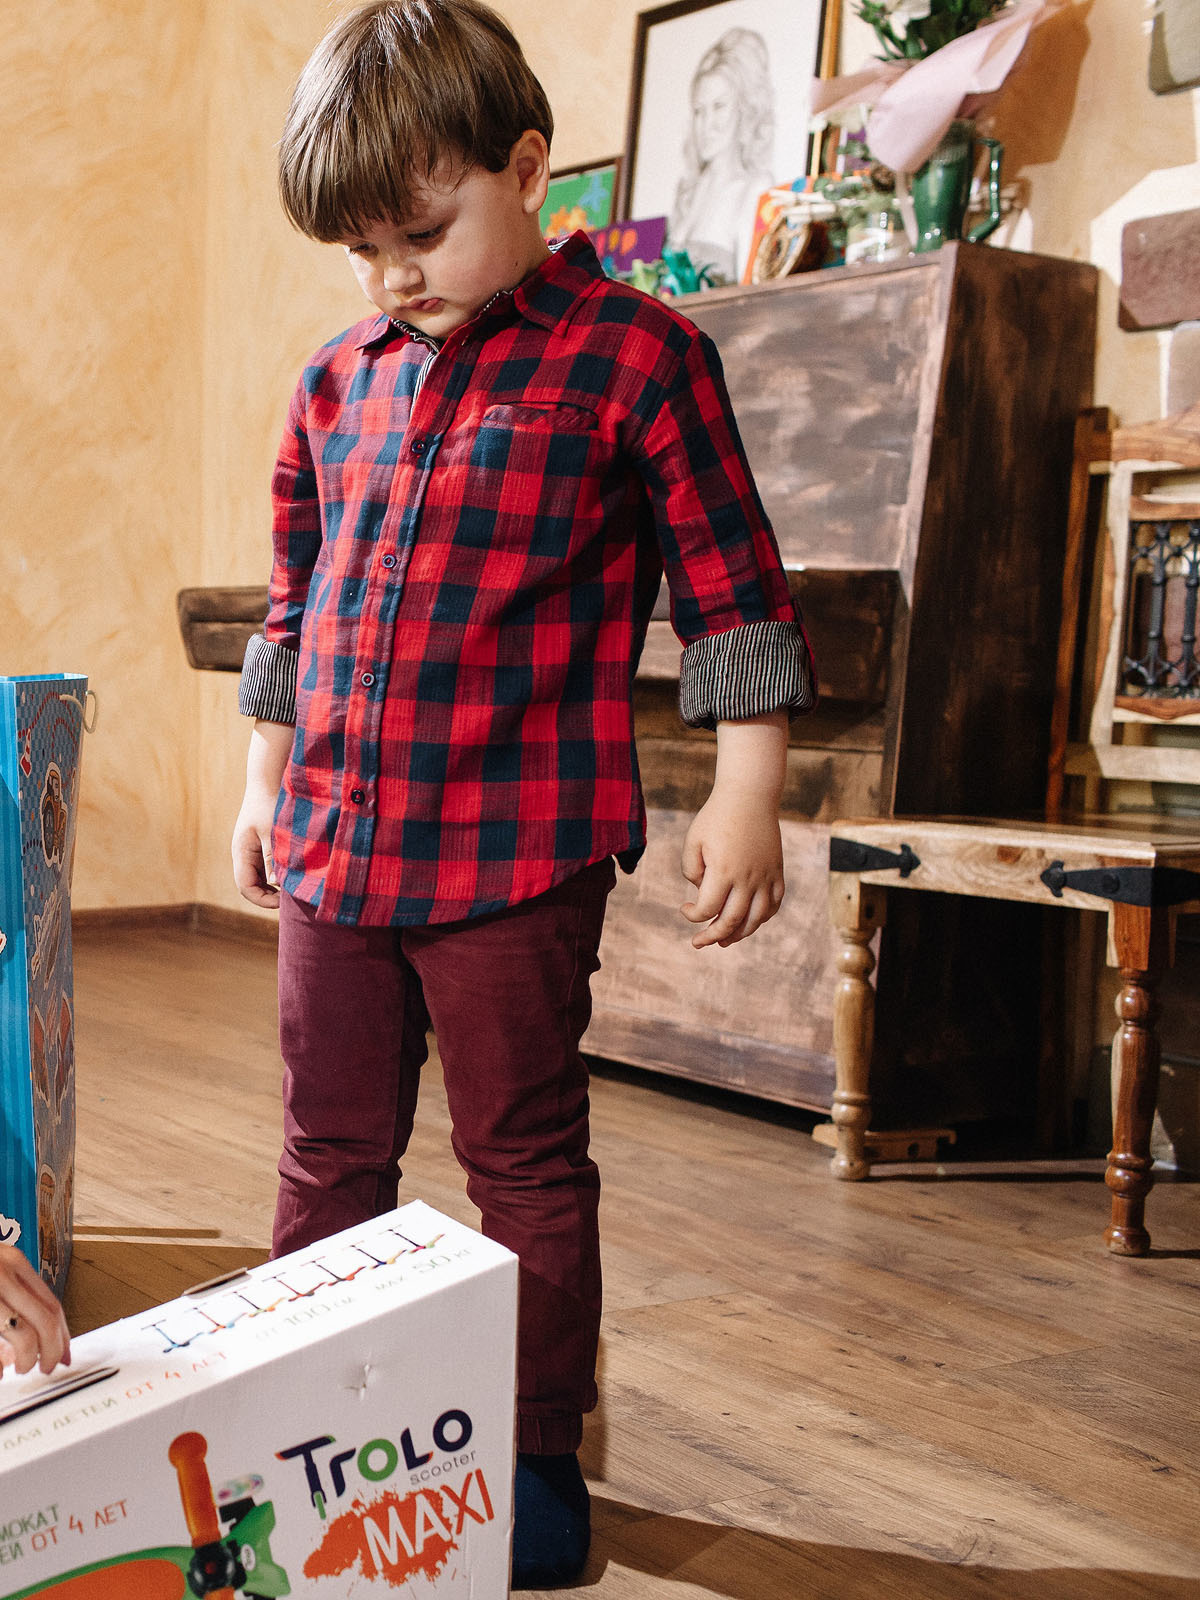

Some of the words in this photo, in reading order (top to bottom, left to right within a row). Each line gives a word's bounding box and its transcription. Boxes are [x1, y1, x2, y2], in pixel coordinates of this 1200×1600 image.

[3, 1428, 42, 1450] ДЛЯ
[125, 1381, 155, 1399] ОТ
[164, 1370, 181, 1381] 4
[192, 1351, 228, 1371] ЛЕТ
[410, 1450, 477, 1486] scooter
[31, 1525, 59, 1552] ОТ
[68, 1514, 84, 1535] 4
[94, 1498, 128, 1529] ЛЕТ
[363, 1468, 494, 1571] MAXI
